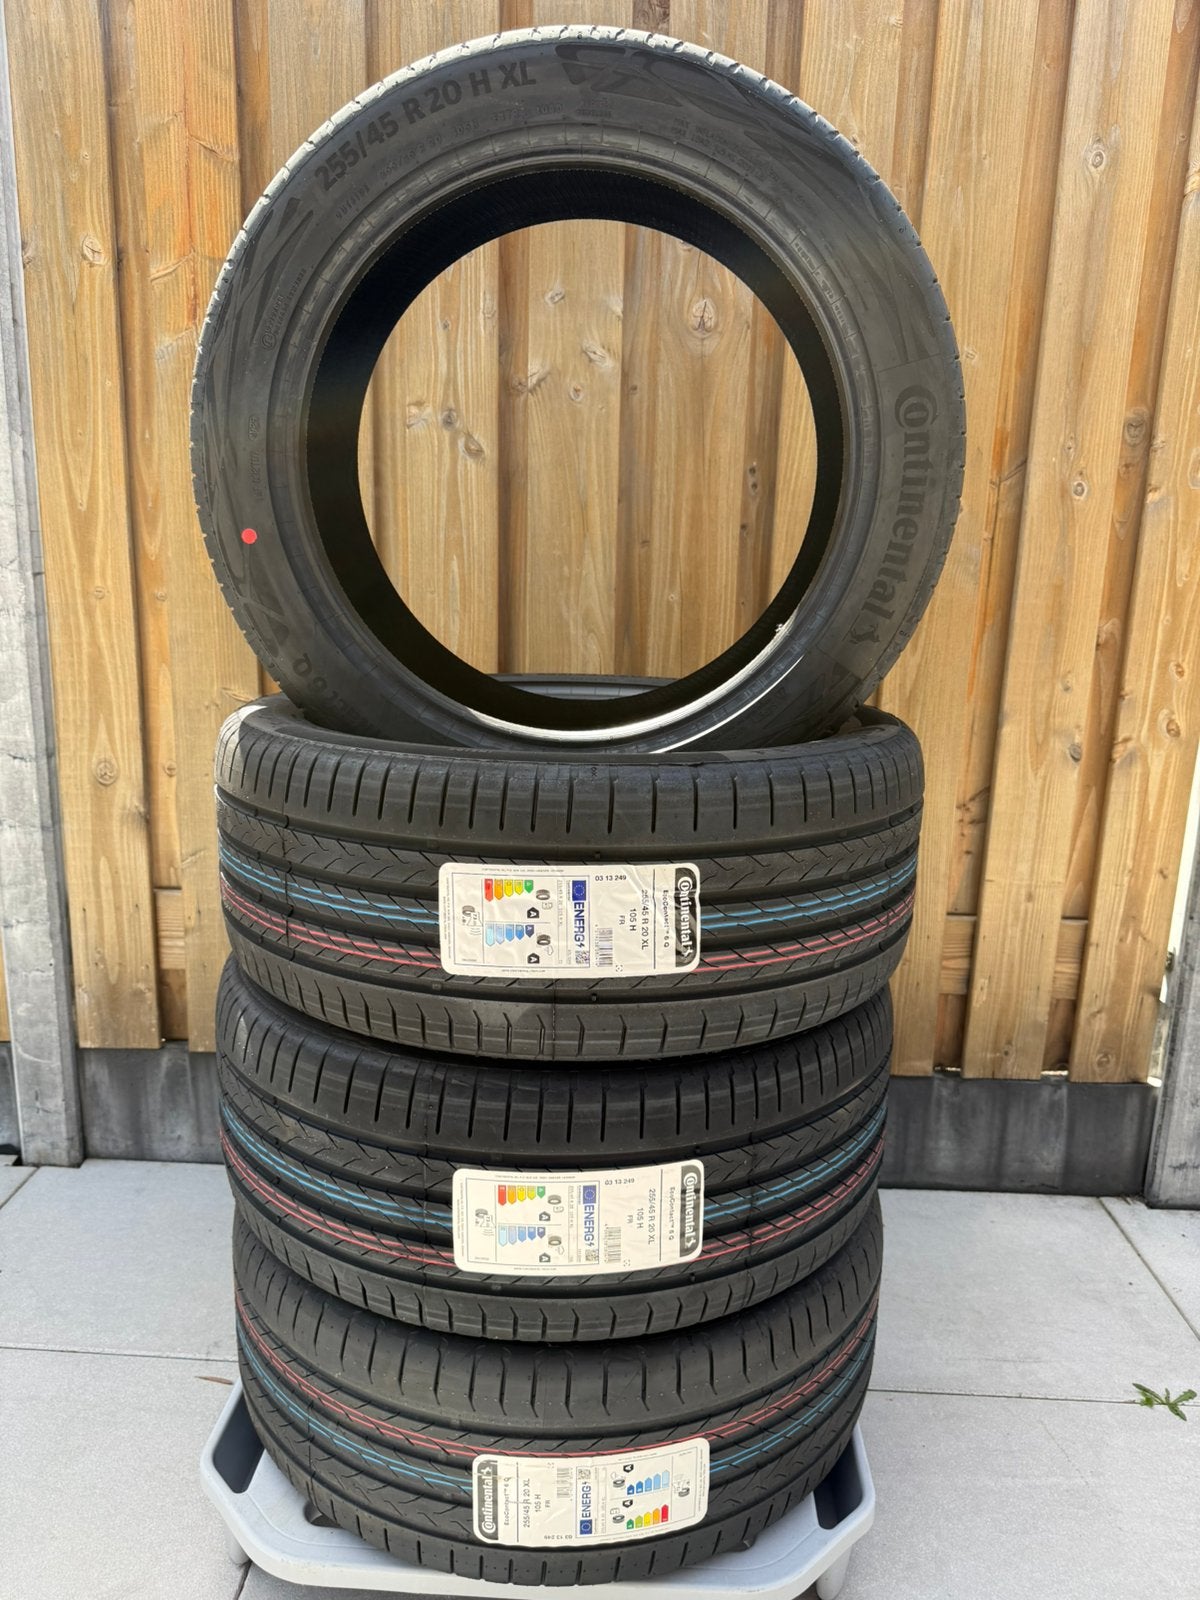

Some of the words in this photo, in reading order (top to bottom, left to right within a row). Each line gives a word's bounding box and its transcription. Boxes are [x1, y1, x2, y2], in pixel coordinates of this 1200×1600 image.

[314, 113, 399, 192] 255/45
[402, 98, 425, 125] R
[425, 80, 462, 114] 20
[469, 73, 492, 97] H
[501, 61, 536, 87] XL
[861, 384, 938, 620] Continental
[641, 890, 649, 916] 255/45
[678, 877, 693, 946] Continental
[574, 902, 584, 942] ENERG
[619, 915, 625, 925] FR
[642, 927, 649, 937] 20
[642, 939, 649, 950] XL
[648, 1188, 656, 1213] 255/45
[684, 1172, 698, 1236] Continental
[584, 1205, 594, 1241] ENERG
[627, 1215, 633, 1223] FR
[648, 1224, 655, 1233] 20
[648, 1234, 655, 1244] XL
[523, 1479, 530, 1487] XL
[523, 1489, 530, 1497] 20
[482, 1476, 496, 1533] Continental
[545, 1500, 550, 1508] FR
[582, 1486, 591, 1518] ENERG
